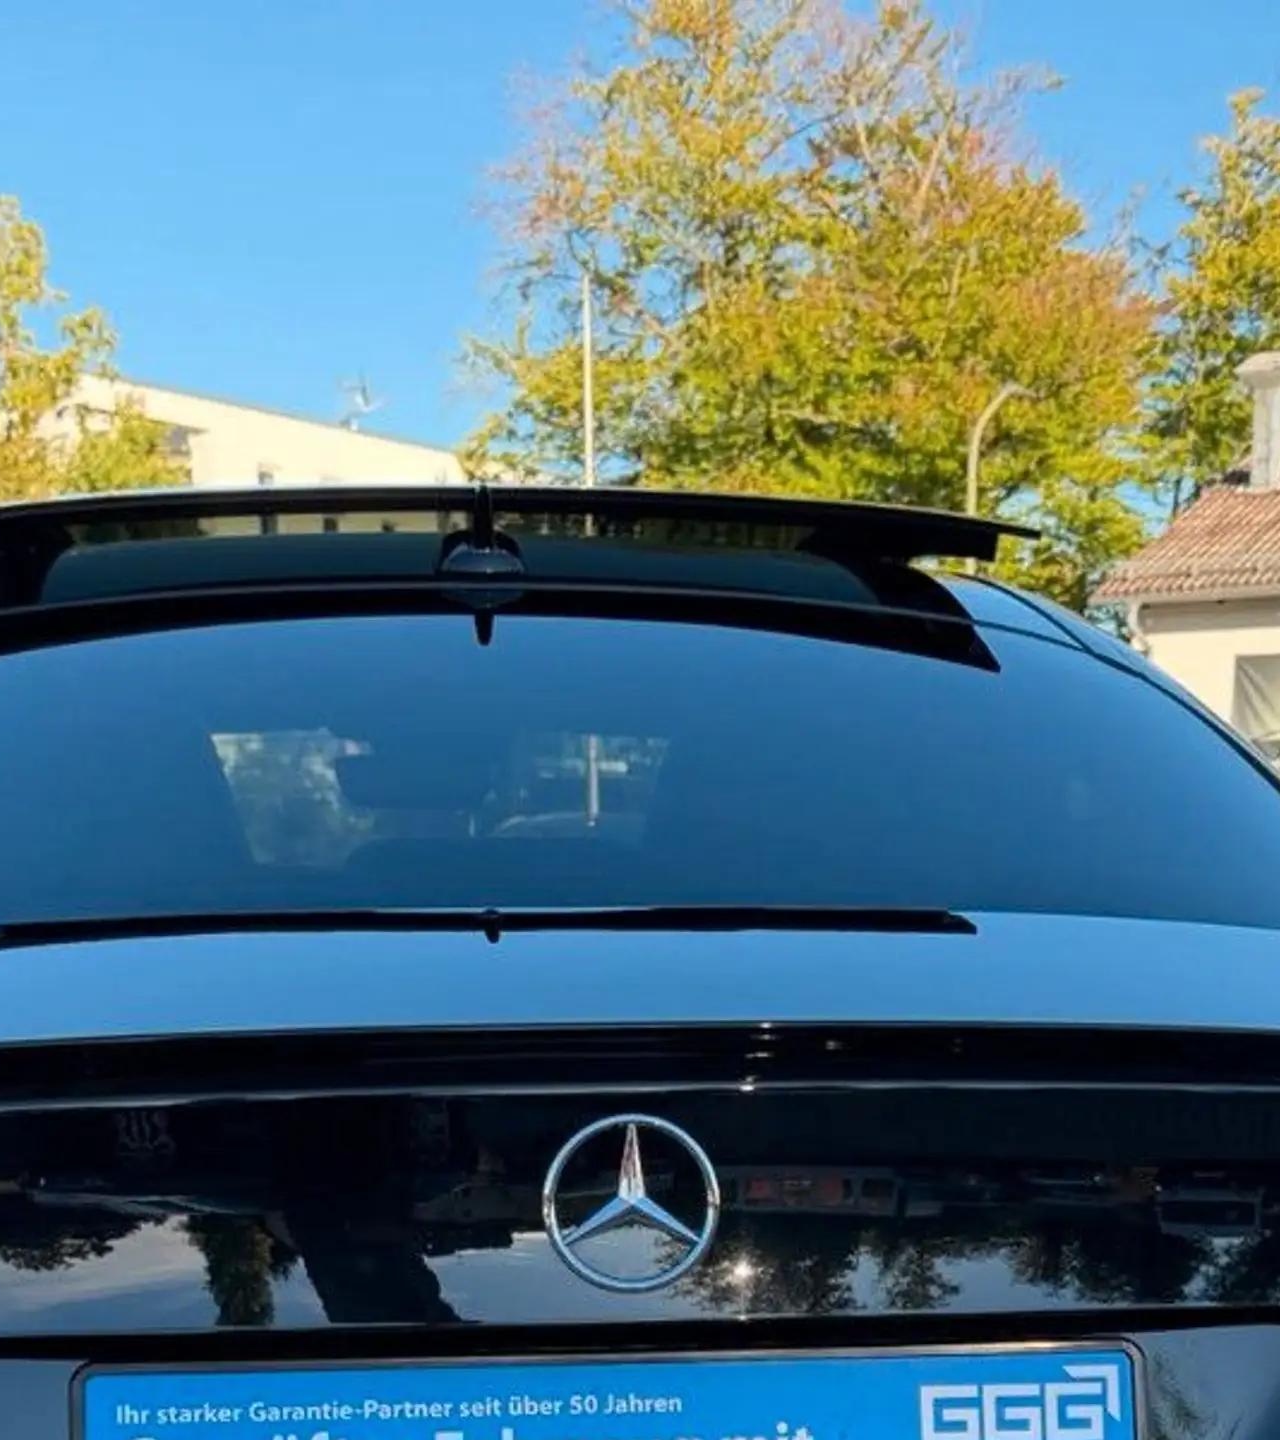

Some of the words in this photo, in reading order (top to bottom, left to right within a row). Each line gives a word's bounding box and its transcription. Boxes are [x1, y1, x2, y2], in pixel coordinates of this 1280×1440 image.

[116, 1404, 149, 1425] Ihr
[157, 1403, 241, 1424] starker
[248, 1398, 452, 1423] Garantie-Partner
[460, 1397, 501, 1417] seit
[508, 1395, 562, 1416] über
[569, 1394, 598, 1415] 50
[604, 1393, 683, 1415] Jahren
